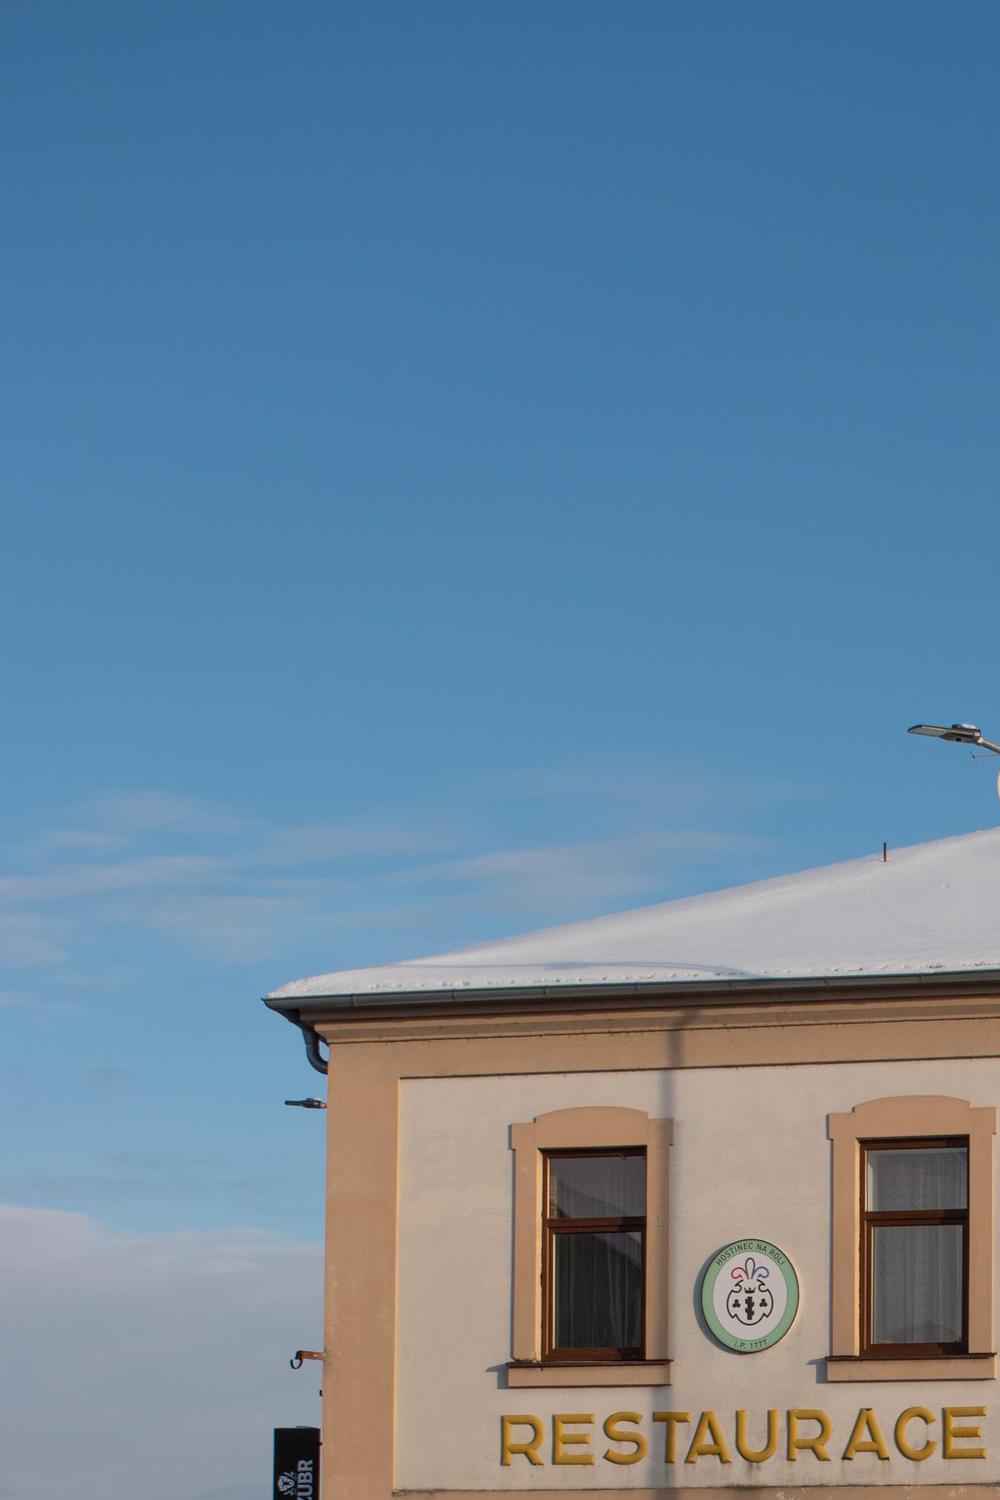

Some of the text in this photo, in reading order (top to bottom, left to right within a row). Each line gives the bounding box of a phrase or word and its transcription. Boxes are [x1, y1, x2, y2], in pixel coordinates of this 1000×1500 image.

[716, 1242, 786, 1266] HOSTINEC NA ROLI
[500, 1405, 988, 1466] RESTAURACE
